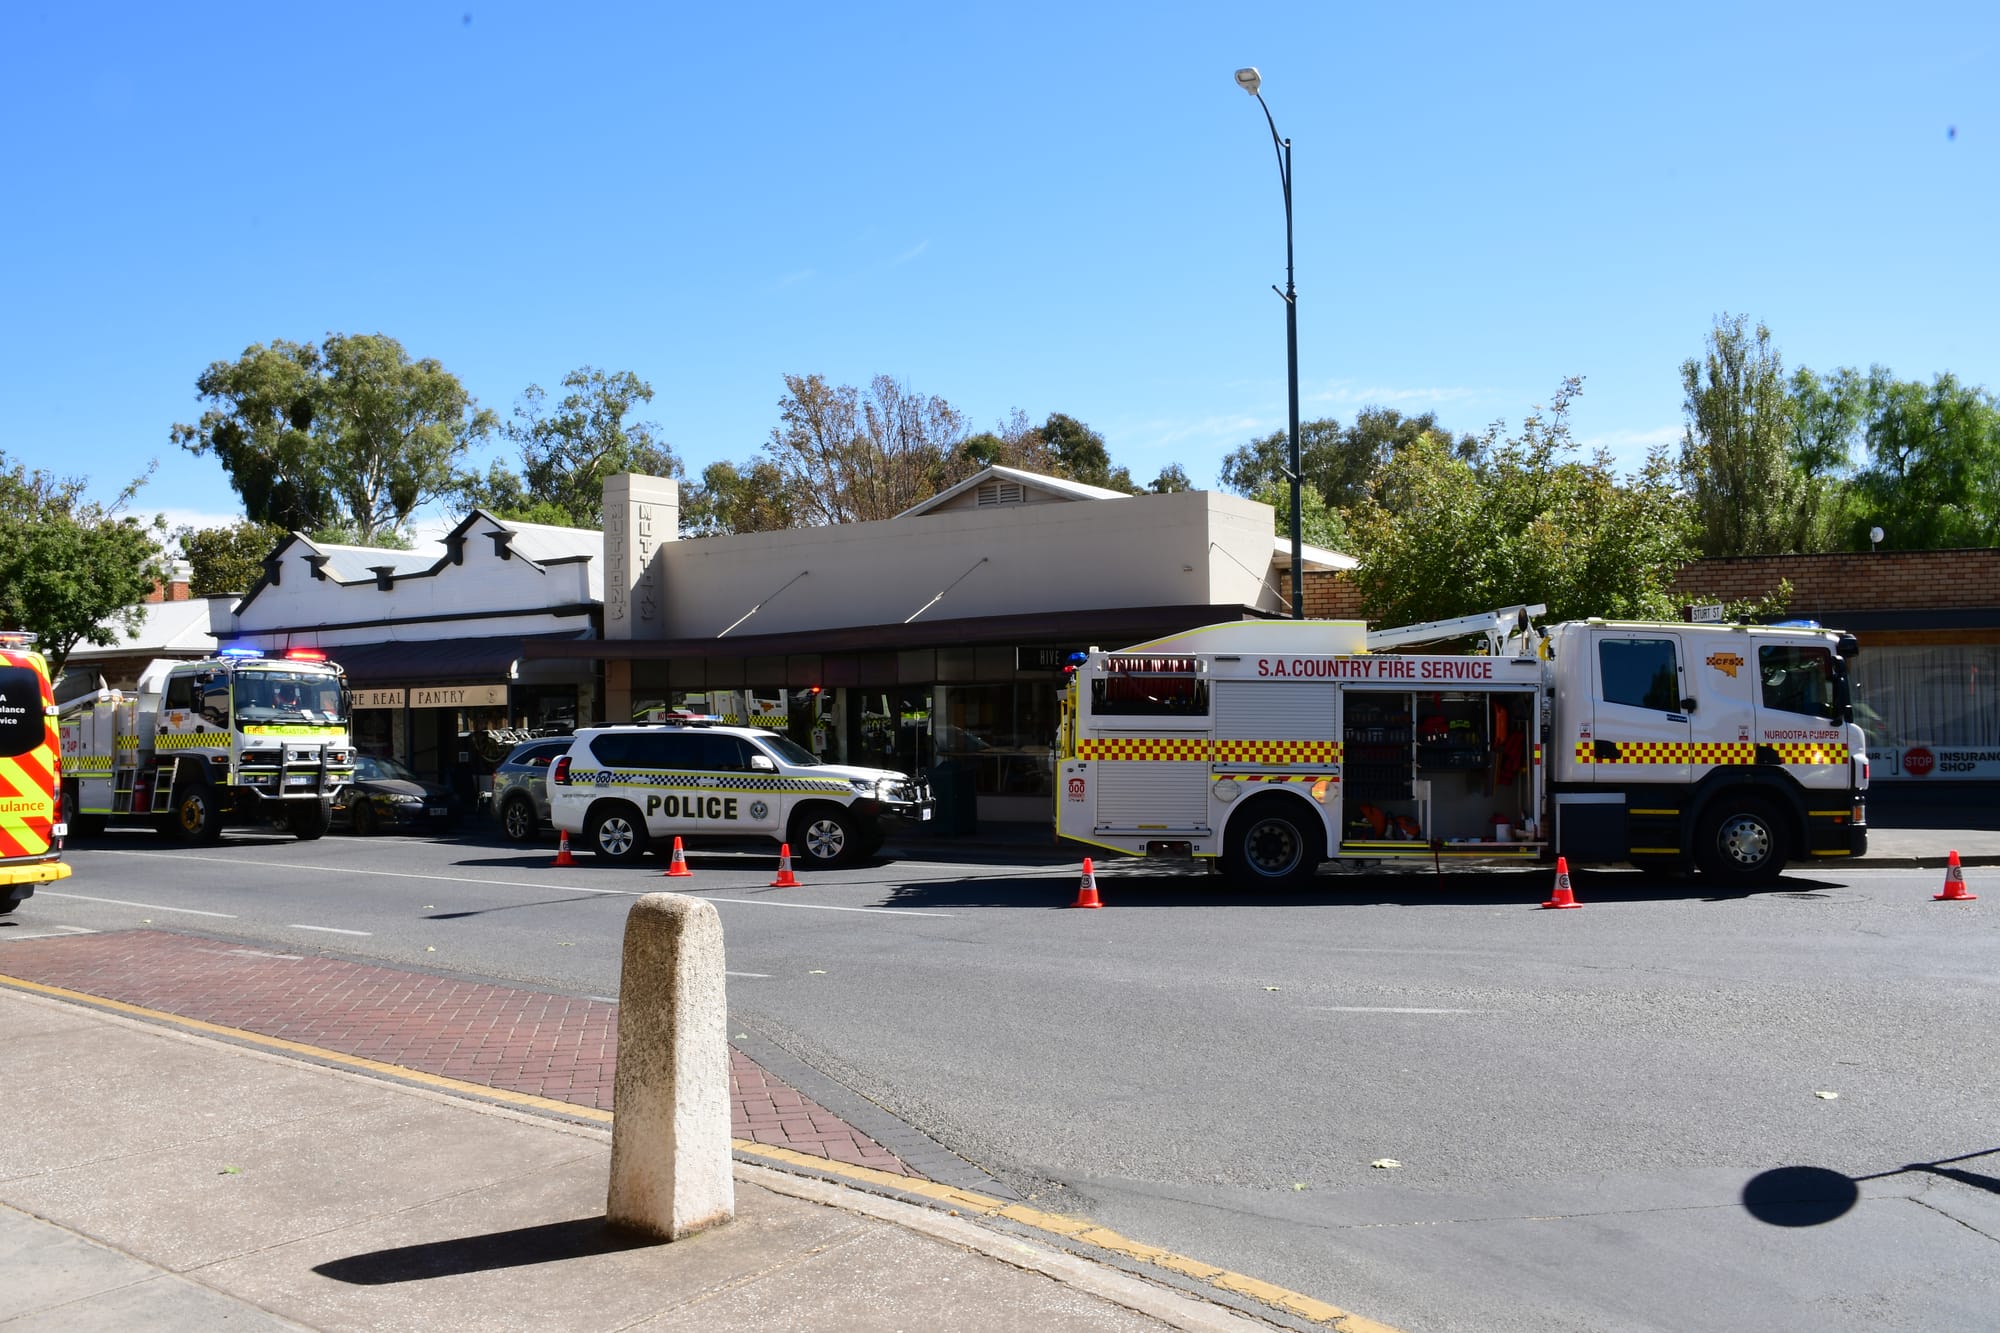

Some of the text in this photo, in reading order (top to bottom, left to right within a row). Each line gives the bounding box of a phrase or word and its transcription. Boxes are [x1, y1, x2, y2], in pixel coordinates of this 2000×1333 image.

[1693, 607, 1719, 620] STURT ST
[1040, 650, 1060, 664] HIVE
[1379, 661, 1415, 678] FIRE
[1421, 662, 1493, 679] SERVICE
[373, 692, 403, 705] REAL
[418, 690, 465, 704] PANTRY
[1764, 730, 1839, 740] NURIOOTPA PUMPER
[1905, 756, 1932, 767] STOP
[1940, 762, 1975, 772] SHOP
[595, 775, 610, 783] 000
[1069, 784, 1085, 793] 000
[647, 795, 738, 820] POLICE
